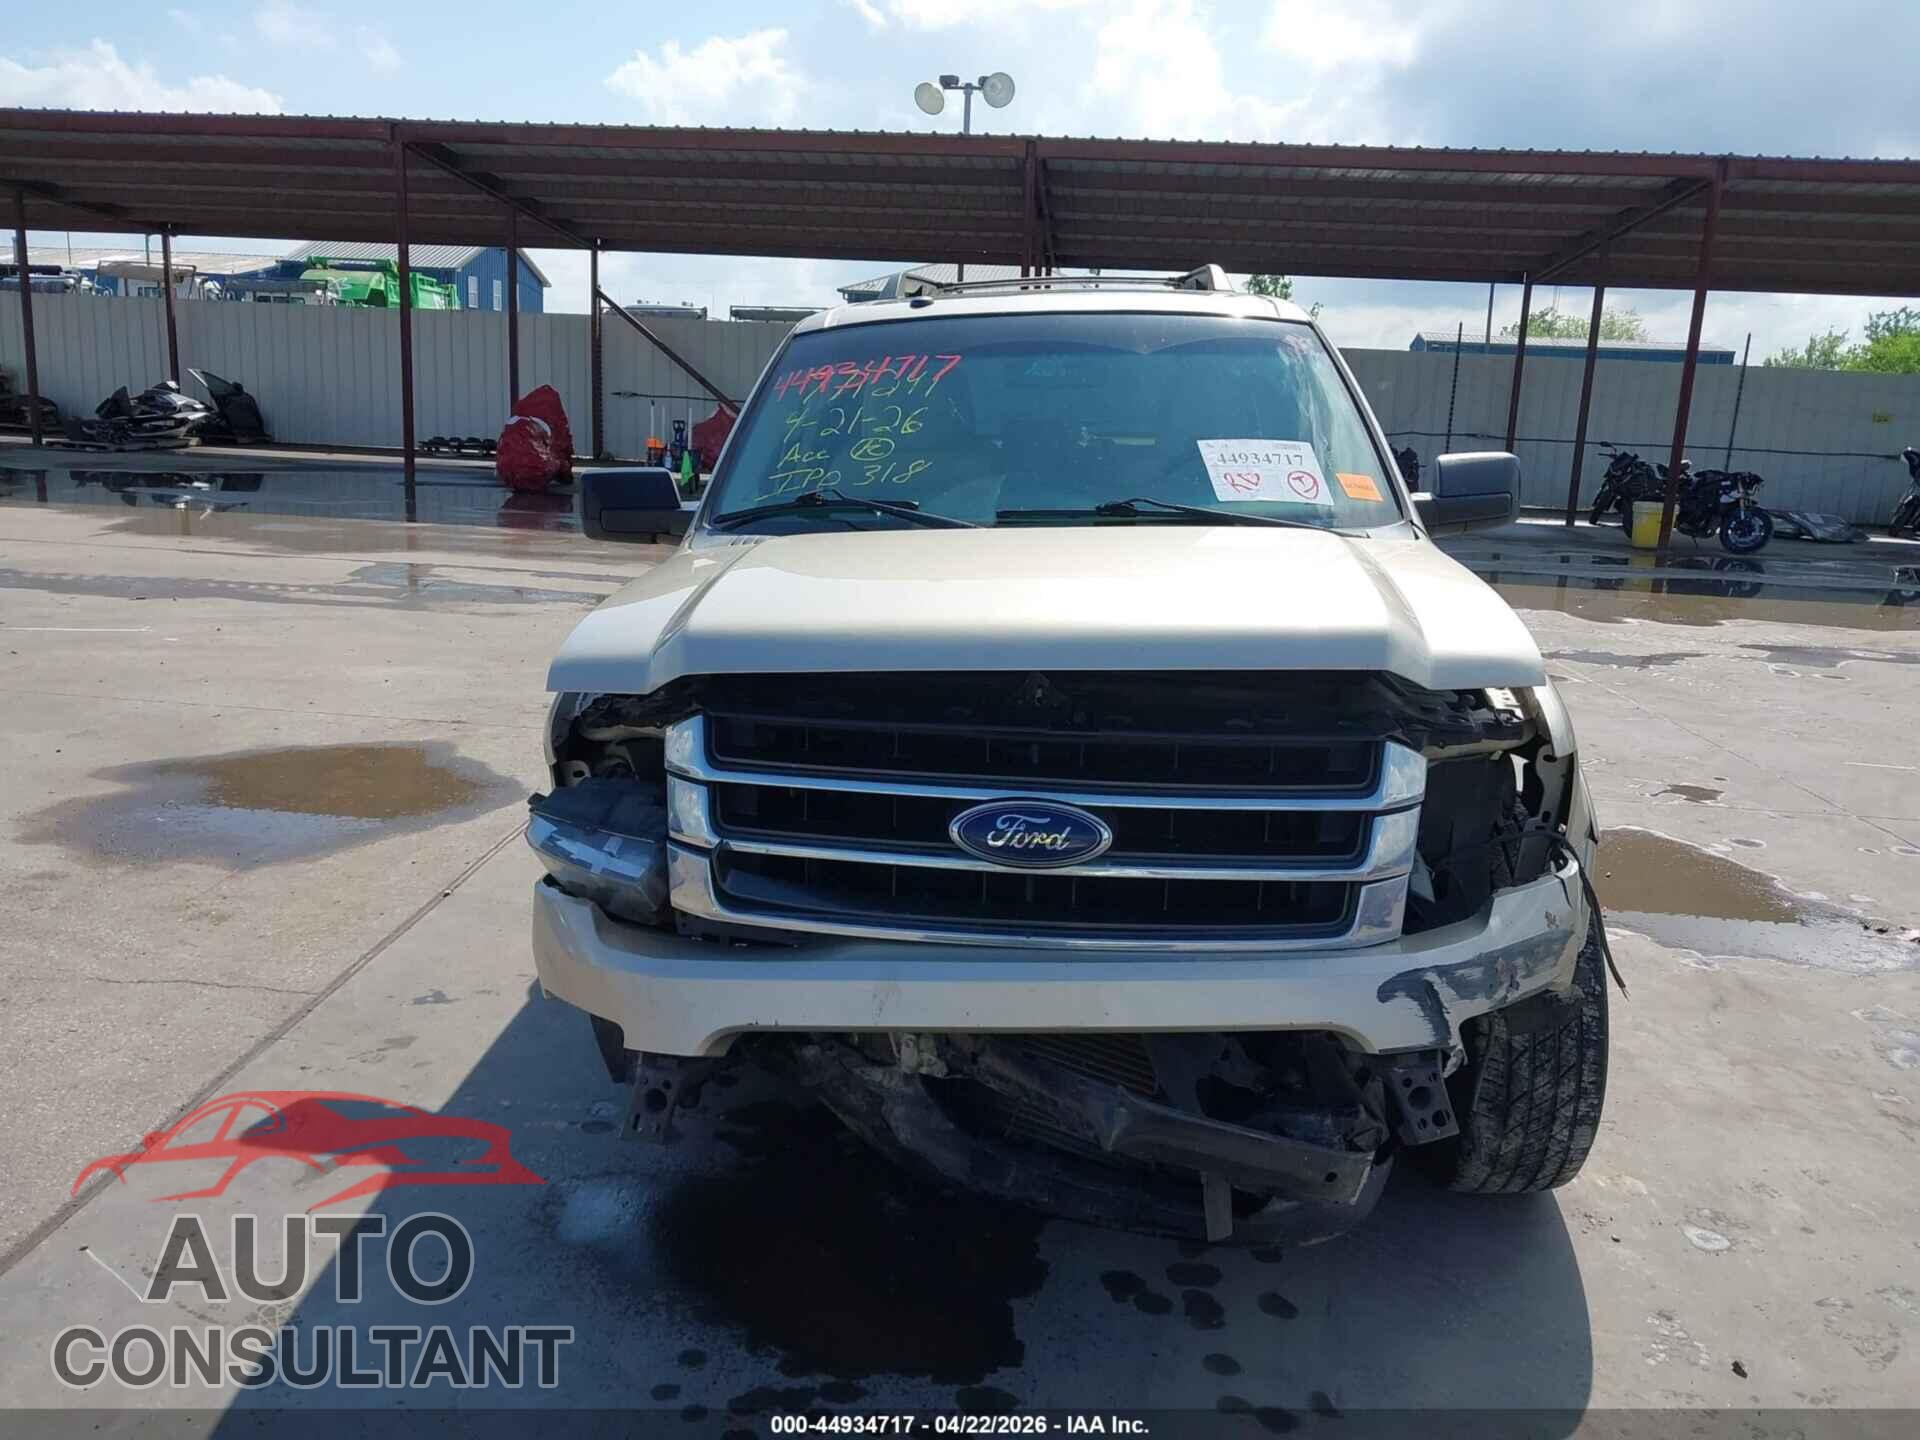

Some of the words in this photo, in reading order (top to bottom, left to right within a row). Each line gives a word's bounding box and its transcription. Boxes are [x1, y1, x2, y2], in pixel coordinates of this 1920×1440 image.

[775, 355, 962, 402] 44934717
[852, 459, 933, 487] 318
[1217, 452, 1304, 465] 44934717
[986, 814, 1072, 850] Ford
